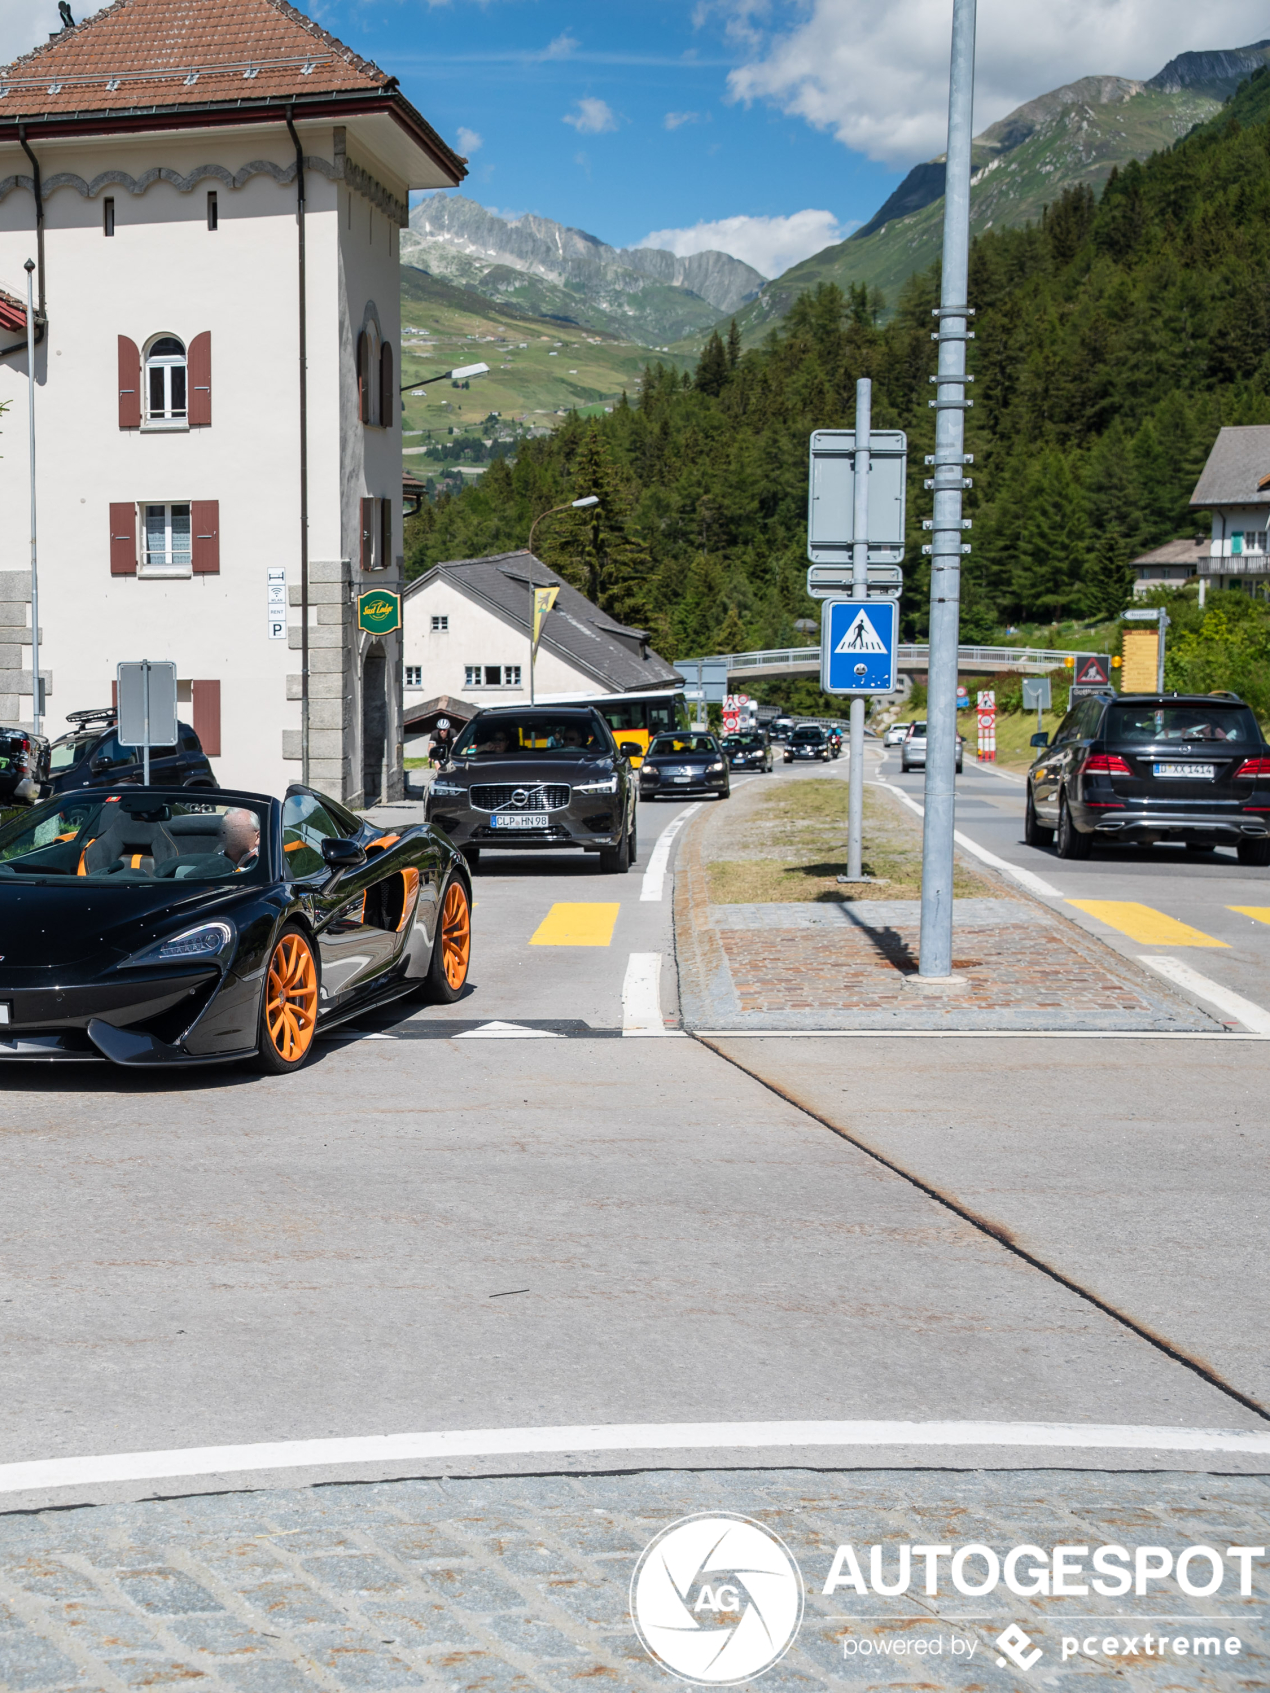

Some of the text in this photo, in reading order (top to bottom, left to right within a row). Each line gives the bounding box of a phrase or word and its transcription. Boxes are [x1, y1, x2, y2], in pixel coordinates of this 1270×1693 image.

[273, 623, 282, 636] P
[496, 816, 547, 826] CLP HN 98
